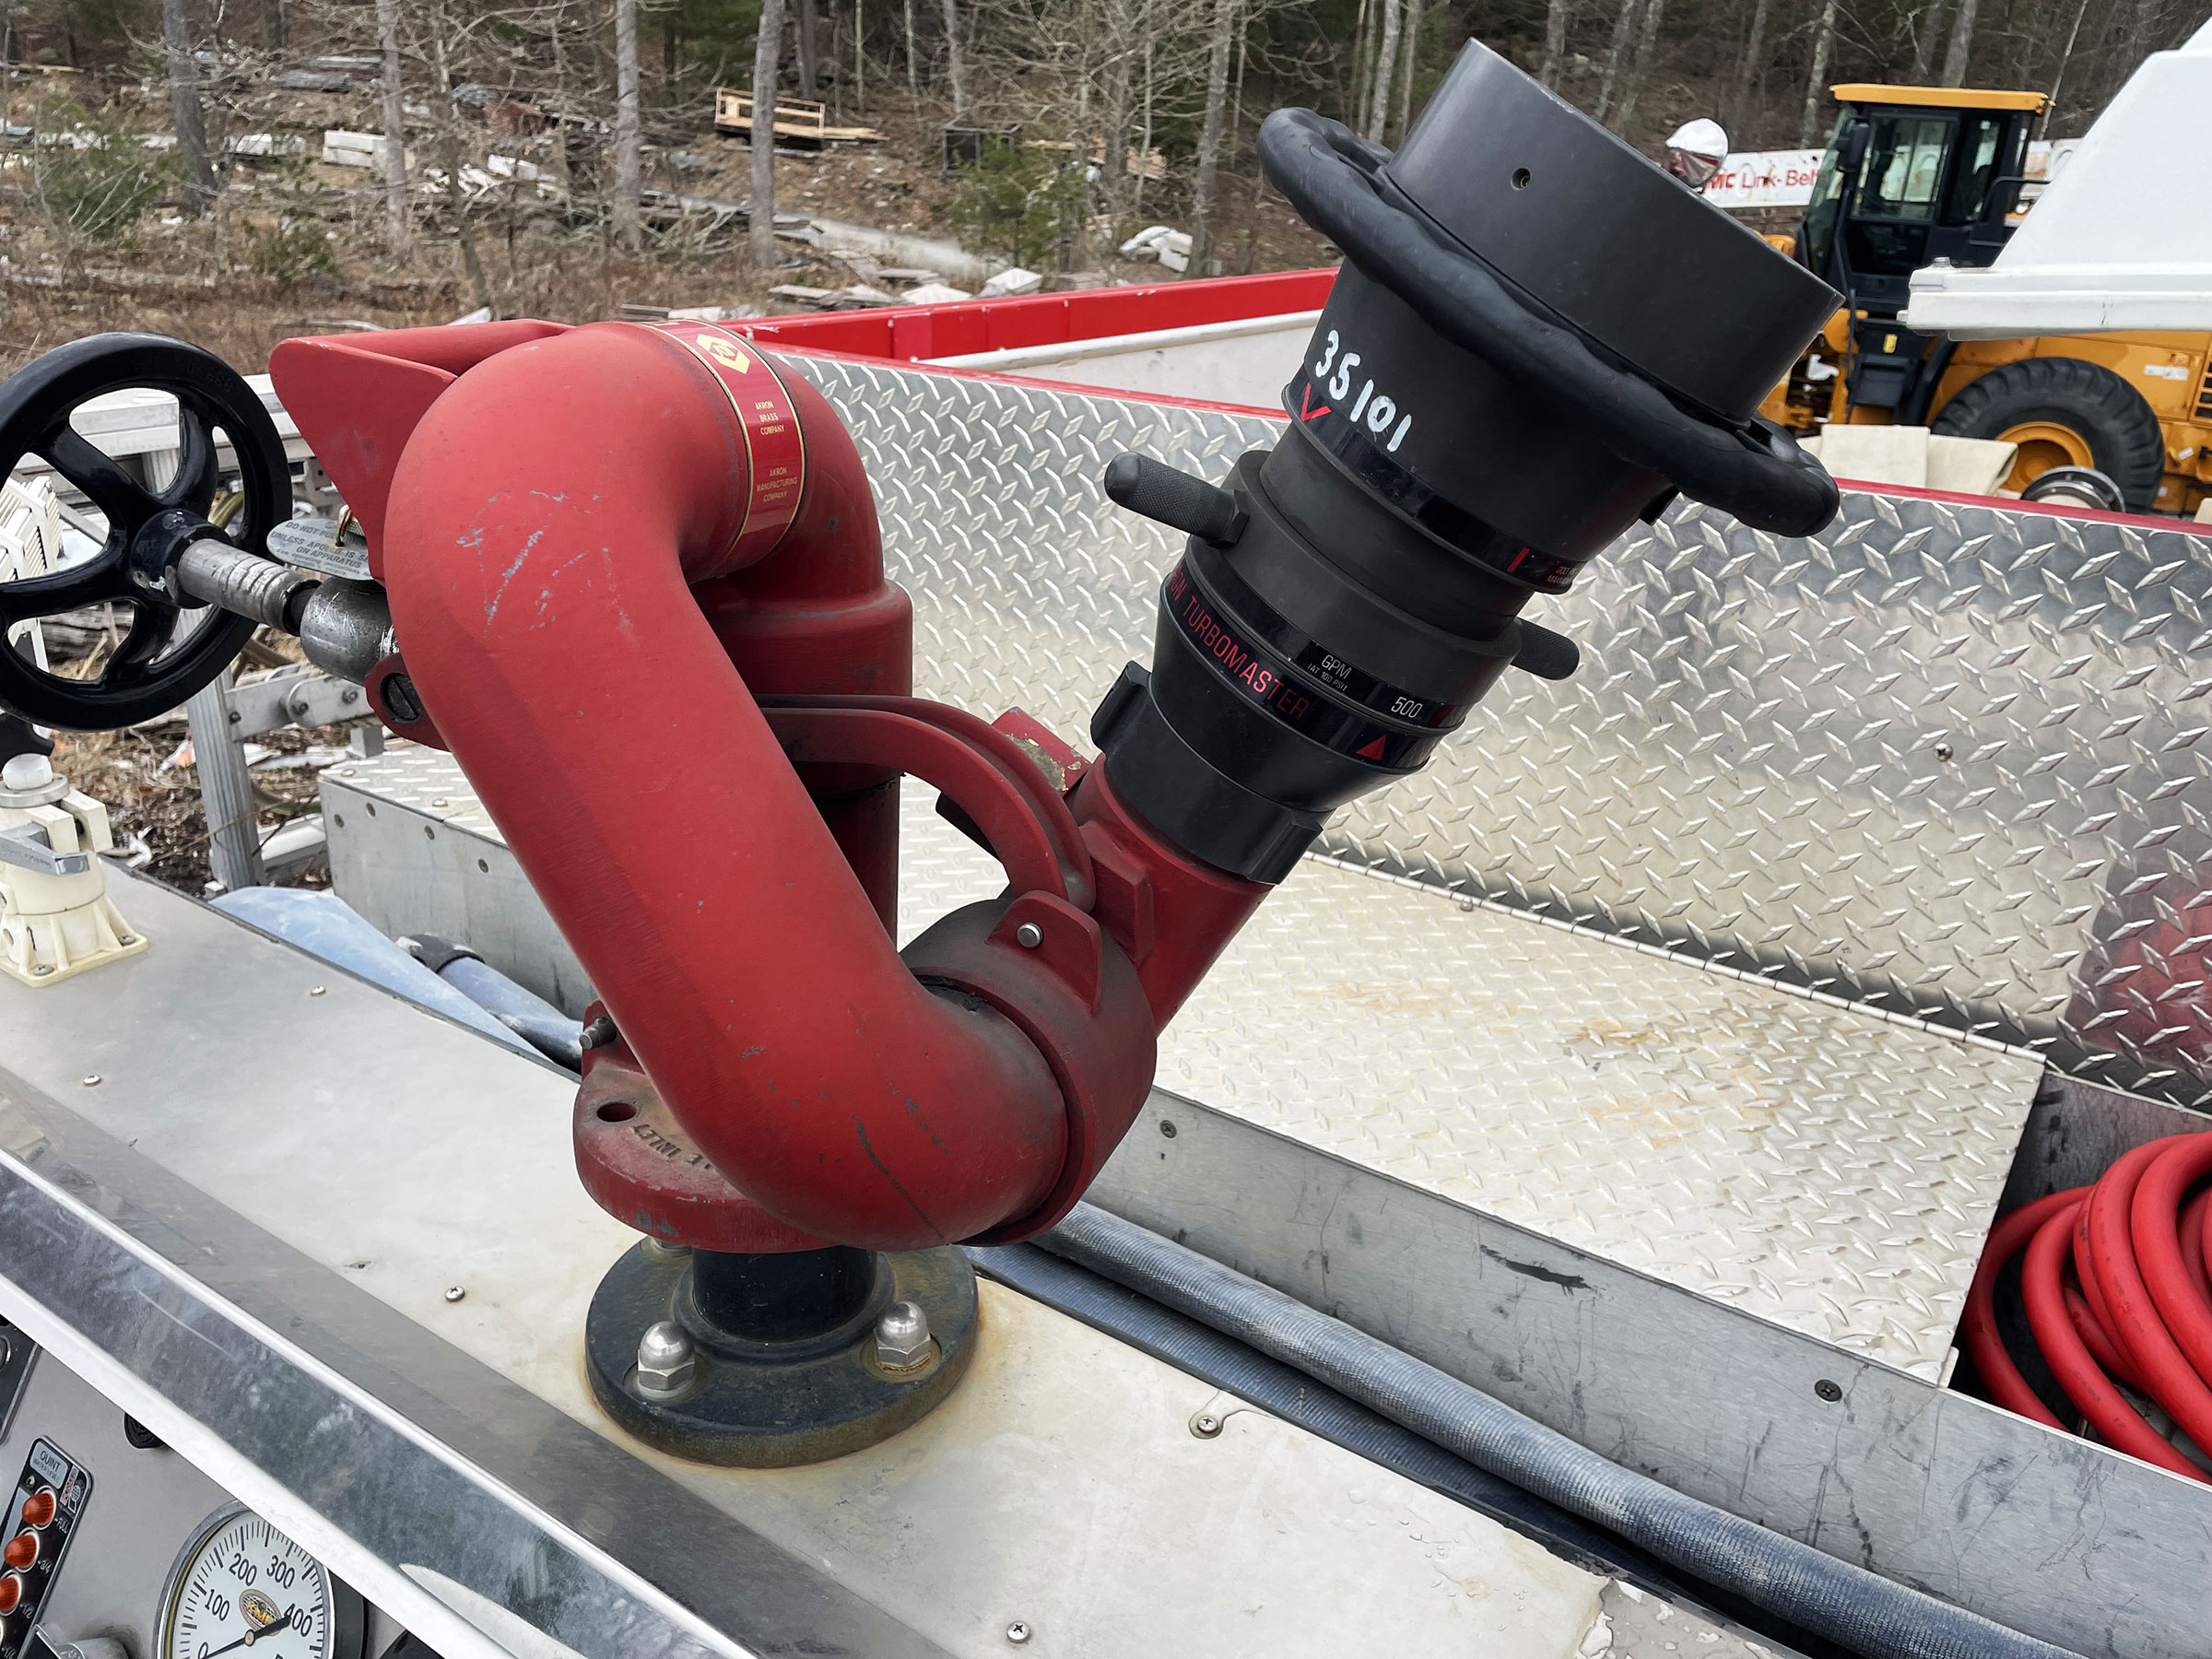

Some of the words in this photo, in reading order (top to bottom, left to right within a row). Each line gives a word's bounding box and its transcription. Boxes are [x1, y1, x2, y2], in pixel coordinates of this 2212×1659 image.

[1704, 173, 1735, 189] MC
[1315, 329, 1412, 453] 35101
[754, 401, 774, 411] AKRON
[759, 413, 779, 422] BRASS
[760, 424, 784, 436] COMPANY
[770, 466, 787, 477] AKRON
[757, 477, 798, 492] MANUFACTURING
[763, 490, 787, 502] COMPANY
[286, 522, 299, 530] DO
[300, 524, 320, 535] NOT
[270, 531, 305, 545] UNLESS
[345, 550, 356, 559] IS
[296, 546, 308, 555] ON
[310, 550, 362, 569] APPARATUS
[1182, 595, 1310, 720] TURBOMASTER
[1321, 654, 1353, 679] GPM
[1307, 663, 1321, 675] (AT
[1321, 671, 1334, 683] 100
[1332, 679, 1348, 691] PSI)
[1391, 696, 1423, 719] 500
[40, 1451, 61, 1471] QUINT
[228, 1552, 258, 1587] 200
[266, 1554, 296, 1590] 300
[204, 1588, 230, 1622] 100
[283, 1603, 313, 1638] 400
